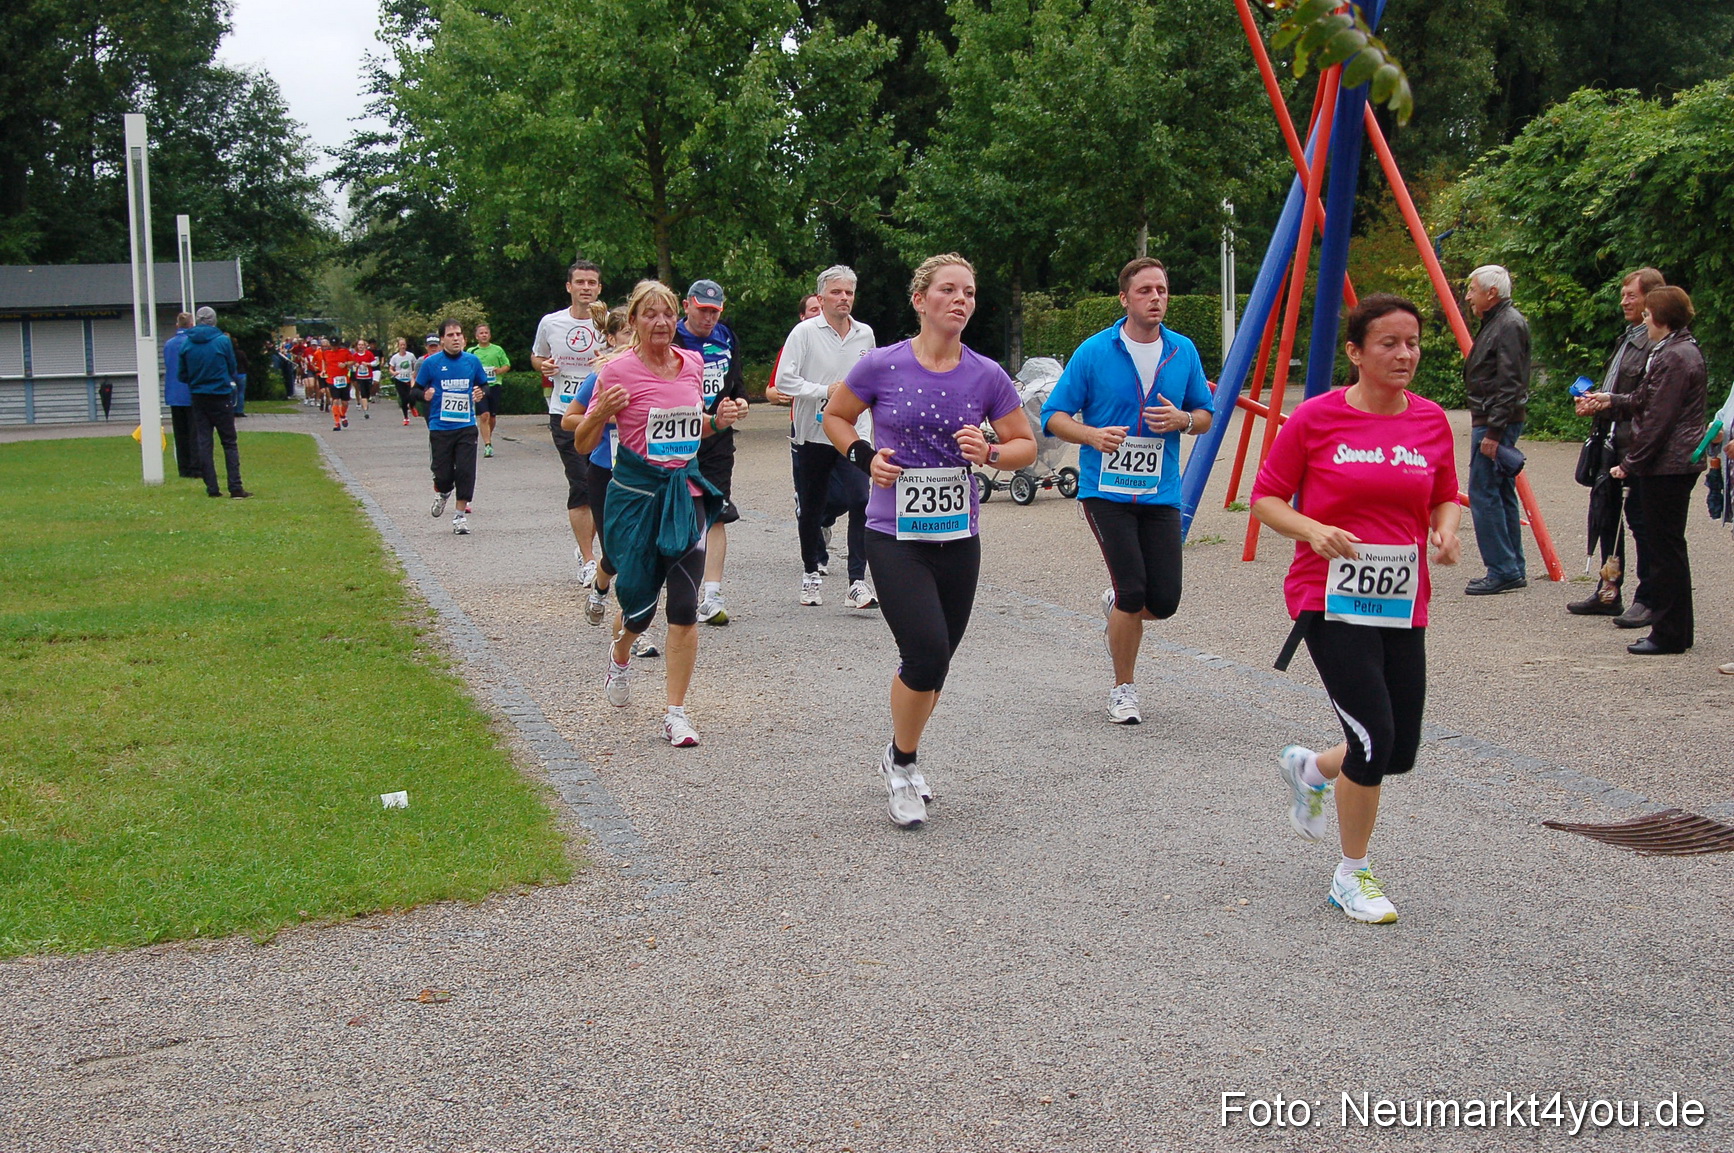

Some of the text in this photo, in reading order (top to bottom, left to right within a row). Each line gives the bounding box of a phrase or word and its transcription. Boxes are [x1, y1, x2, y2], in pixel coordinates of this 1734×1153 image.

[564, 380, 583, 394] 27
[703, 378, 720, 395] 66
[445, 399, 468, 412] 2764
[652, 418, 701, 440] 2910
[661, 444, 693, 454] Johanna
[1125, 441, 1154, 449] Neumarkt
[1108, 450, 1157, 473] 2429
[1333, 443, 1428, 468] Sweet Pain
[898, 475, 961, 483] PARTL Neumarkt
[1114, 476, 1147, 487] Andreas
[905, 484, 965, 513] 2353
[911, 520, 959, 531] Alexandra
[1365, 552, 1408, 563] Neumarkt
[1336, 563, 1411, 595] 2662
[1353, 600, 1383, 614] Petra
